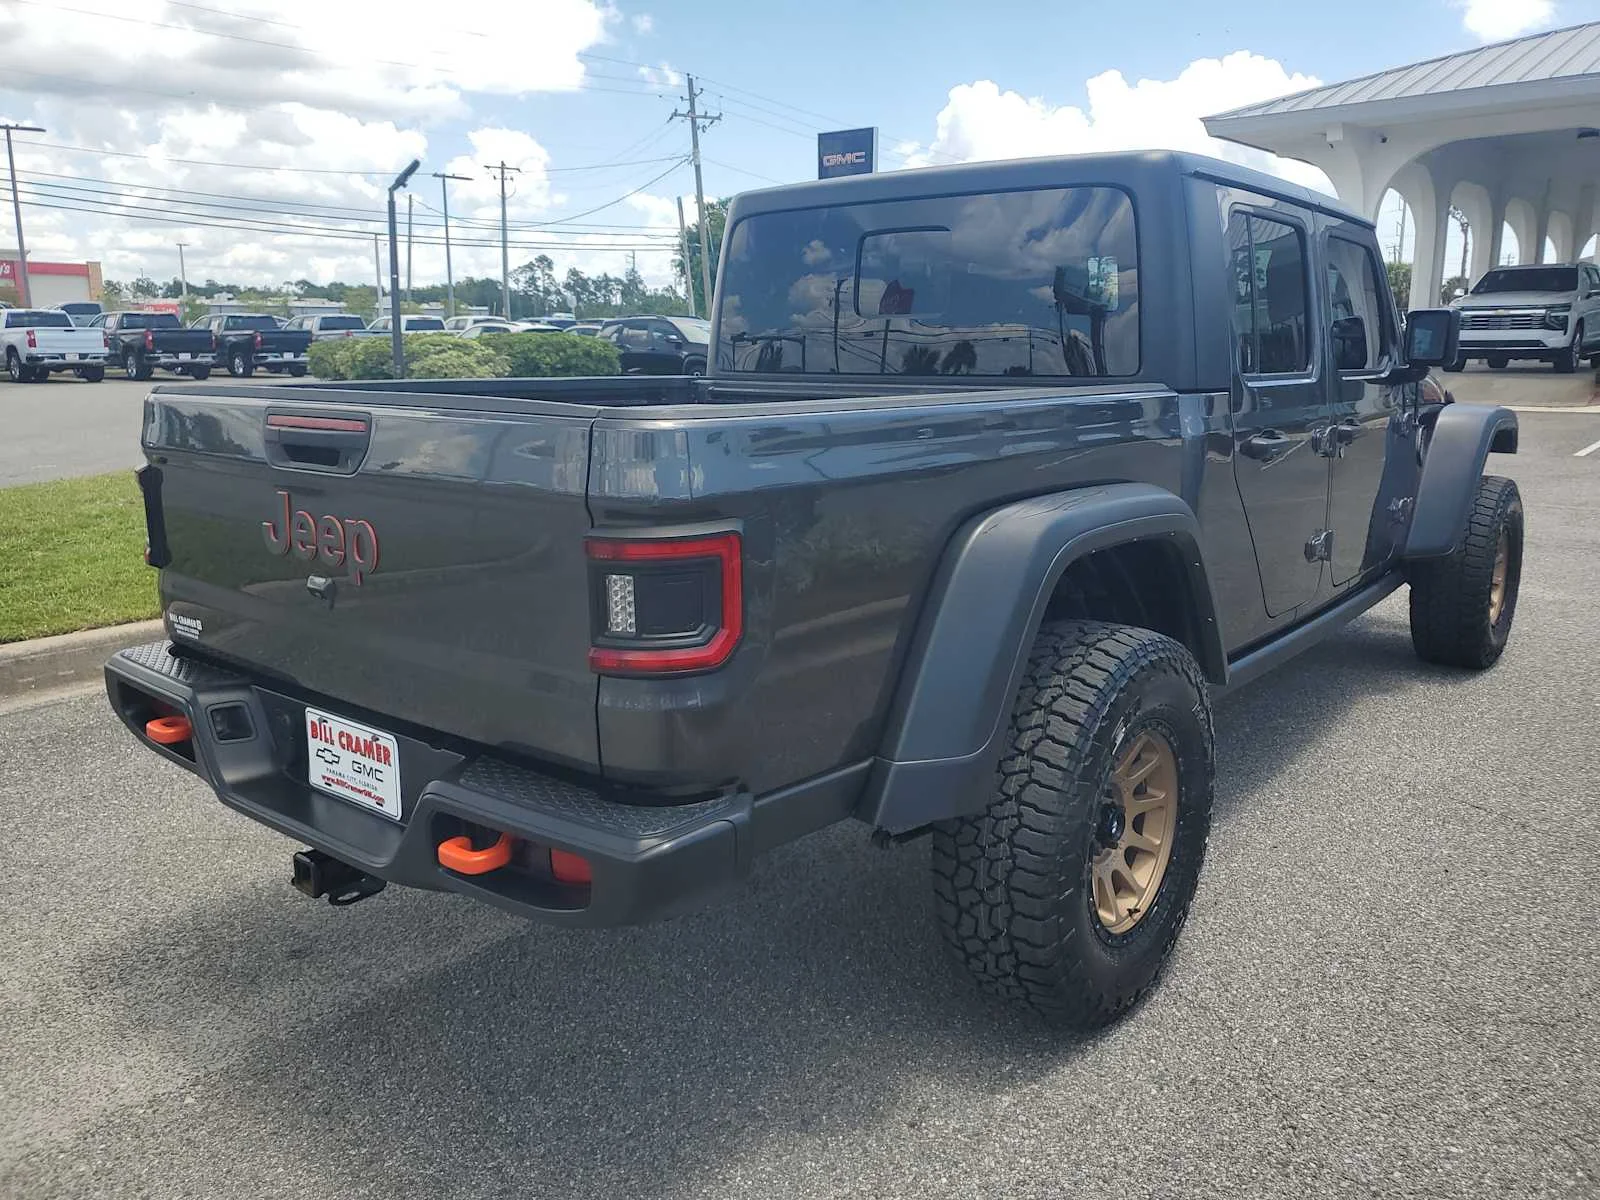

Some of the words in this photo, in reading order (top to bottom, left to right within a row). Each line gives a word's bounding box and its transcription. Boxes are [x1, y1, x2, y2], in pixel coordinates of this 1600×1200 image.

[823, 151, 866, 167] GMC
[262, 487, 379, 586] Jeep
[310, 719, 335, 746] BILL
[338, 730, 392, 767] CRAMER
[352, 760, 384, 783] GMC
